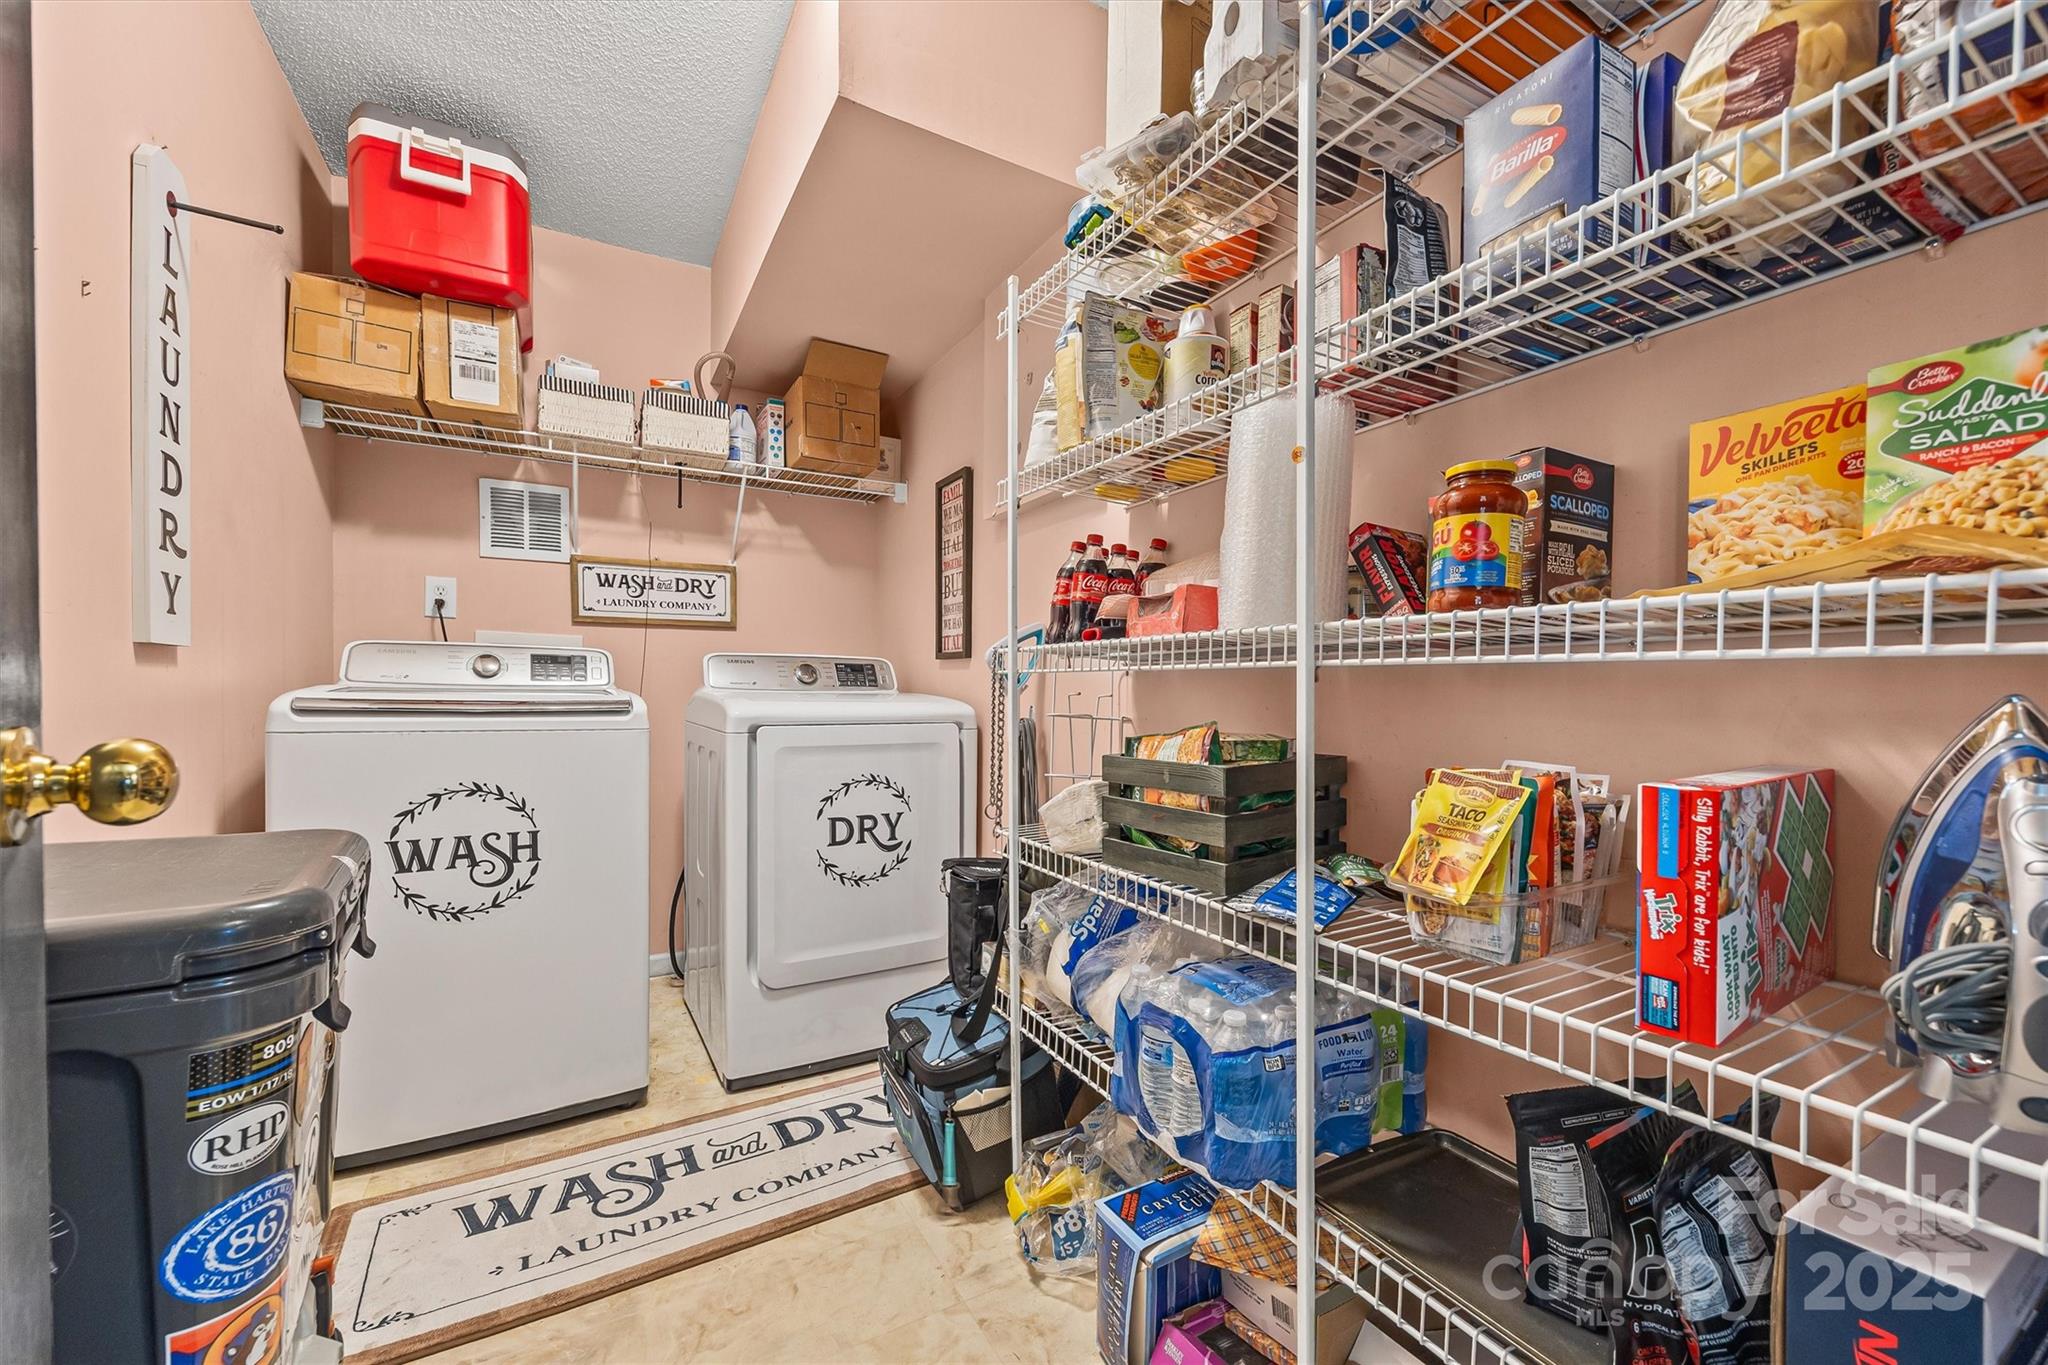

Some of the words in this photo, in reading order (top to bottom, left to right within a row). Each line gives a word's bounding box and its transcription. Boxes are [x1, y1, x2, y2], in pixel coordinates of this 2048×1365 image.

[1494, 71, 1554, 115] RIGATONI
[1490, 134, 1556, 184] Barilla
[1908, 371, 1957, 391] Crocker
[1917, 365, 1951, 380] Betty
[1892, 371, 2048, 429] Suddenl
[159, 225, 188, 616] LAUNDRY
[1699, 394, 1868, 477] Velveeta
[1909, 412, 2046, 450] SALAD
[1953, 412, 1998, 427] PASTA
[1740, 440, 1819, 475] SKILLETS
[1920, 444, 1960, 462] RANCH
[1971, 436, 2015, 452] BACON
[1735, 473, 1753, 484] ONE
[1753, 468, 1772, 479] PAN
[1772, 458, 1806, 473] DINNER
[1806, 450, 1827, 463] KITS
[1550, 494, 1610, 520] SCALLOPED
[1359, 545, 1396, 604] FLAVOR
[1547, 555, 1575, 568] SLICED
[1547, 565, 1575, 576] POTATOES
[595, 572, 655, 599] WASH
[656, 576, 674, 592] and
[674, 577, 717, 599] DRY
[603, 597, 657, 609] LAUNDRY
[659, 600, 713, 611] COMPANY
[1437, 815, 1471, 829] SEASONING
[1449, 803, 1487, 822] TACO
[1691, 796, 1713, 822] Silly
[827, 811, 905, 853] DRY
[1436, 827, 1471, 841] ORIGINAL
[1693, 824, 1713, 867] Rabbit,
[384, 830, 542, 888] WASH
[1694, 868, 1711, 892] Trix
[1653, 893, 1683, 935] Trix
[1695, 894, 1707, 914] are
[1694, 916, 1710, 934] for
[1692, 937, 1710, 969] kids!
[1721, 934, 1733, 979] WHAT
[1730, 924, 1739, 961] INTO
[1740, 918, 1764, 1008] Trix
[1725, 978, 1735, 1021] LOOK
[1732, 961, 1741, 1021] HOPPED
[262, 1034, 295, 1060] 809
[1318, 1035, 1342, 1050] FOOD
[1379, 1024, 1398, 1038] 24
[1336, 1047, 1364, 1058] Water
[198, 1090, 247, 1113] EOW
[250, 1068, 294, 1097] 1/17/18
[202, 1110, 286, 1165] RHP
[1531, 1161, 1558, 1171] Calories
[1572, 1162, 1581, 1172] 25
[451, 1143, 718, 1239] WASH
[706, 1131, 769, 1167] and
[1141, 1179, 1209, 1215] CRYSTAL
[517, 1196, 721, 1273] LAUNDRY
[731, 1140, 898, 1204] COMPANY
[185, 1213, 232, 1254] LAKE
[226, 1209, 279, 1259] 86
[193, 1266, 255, 1288] STATE
[1633, 1322, 1640, 1334] 6
[1641, 1321, 1670, 1334] TROPICAL
